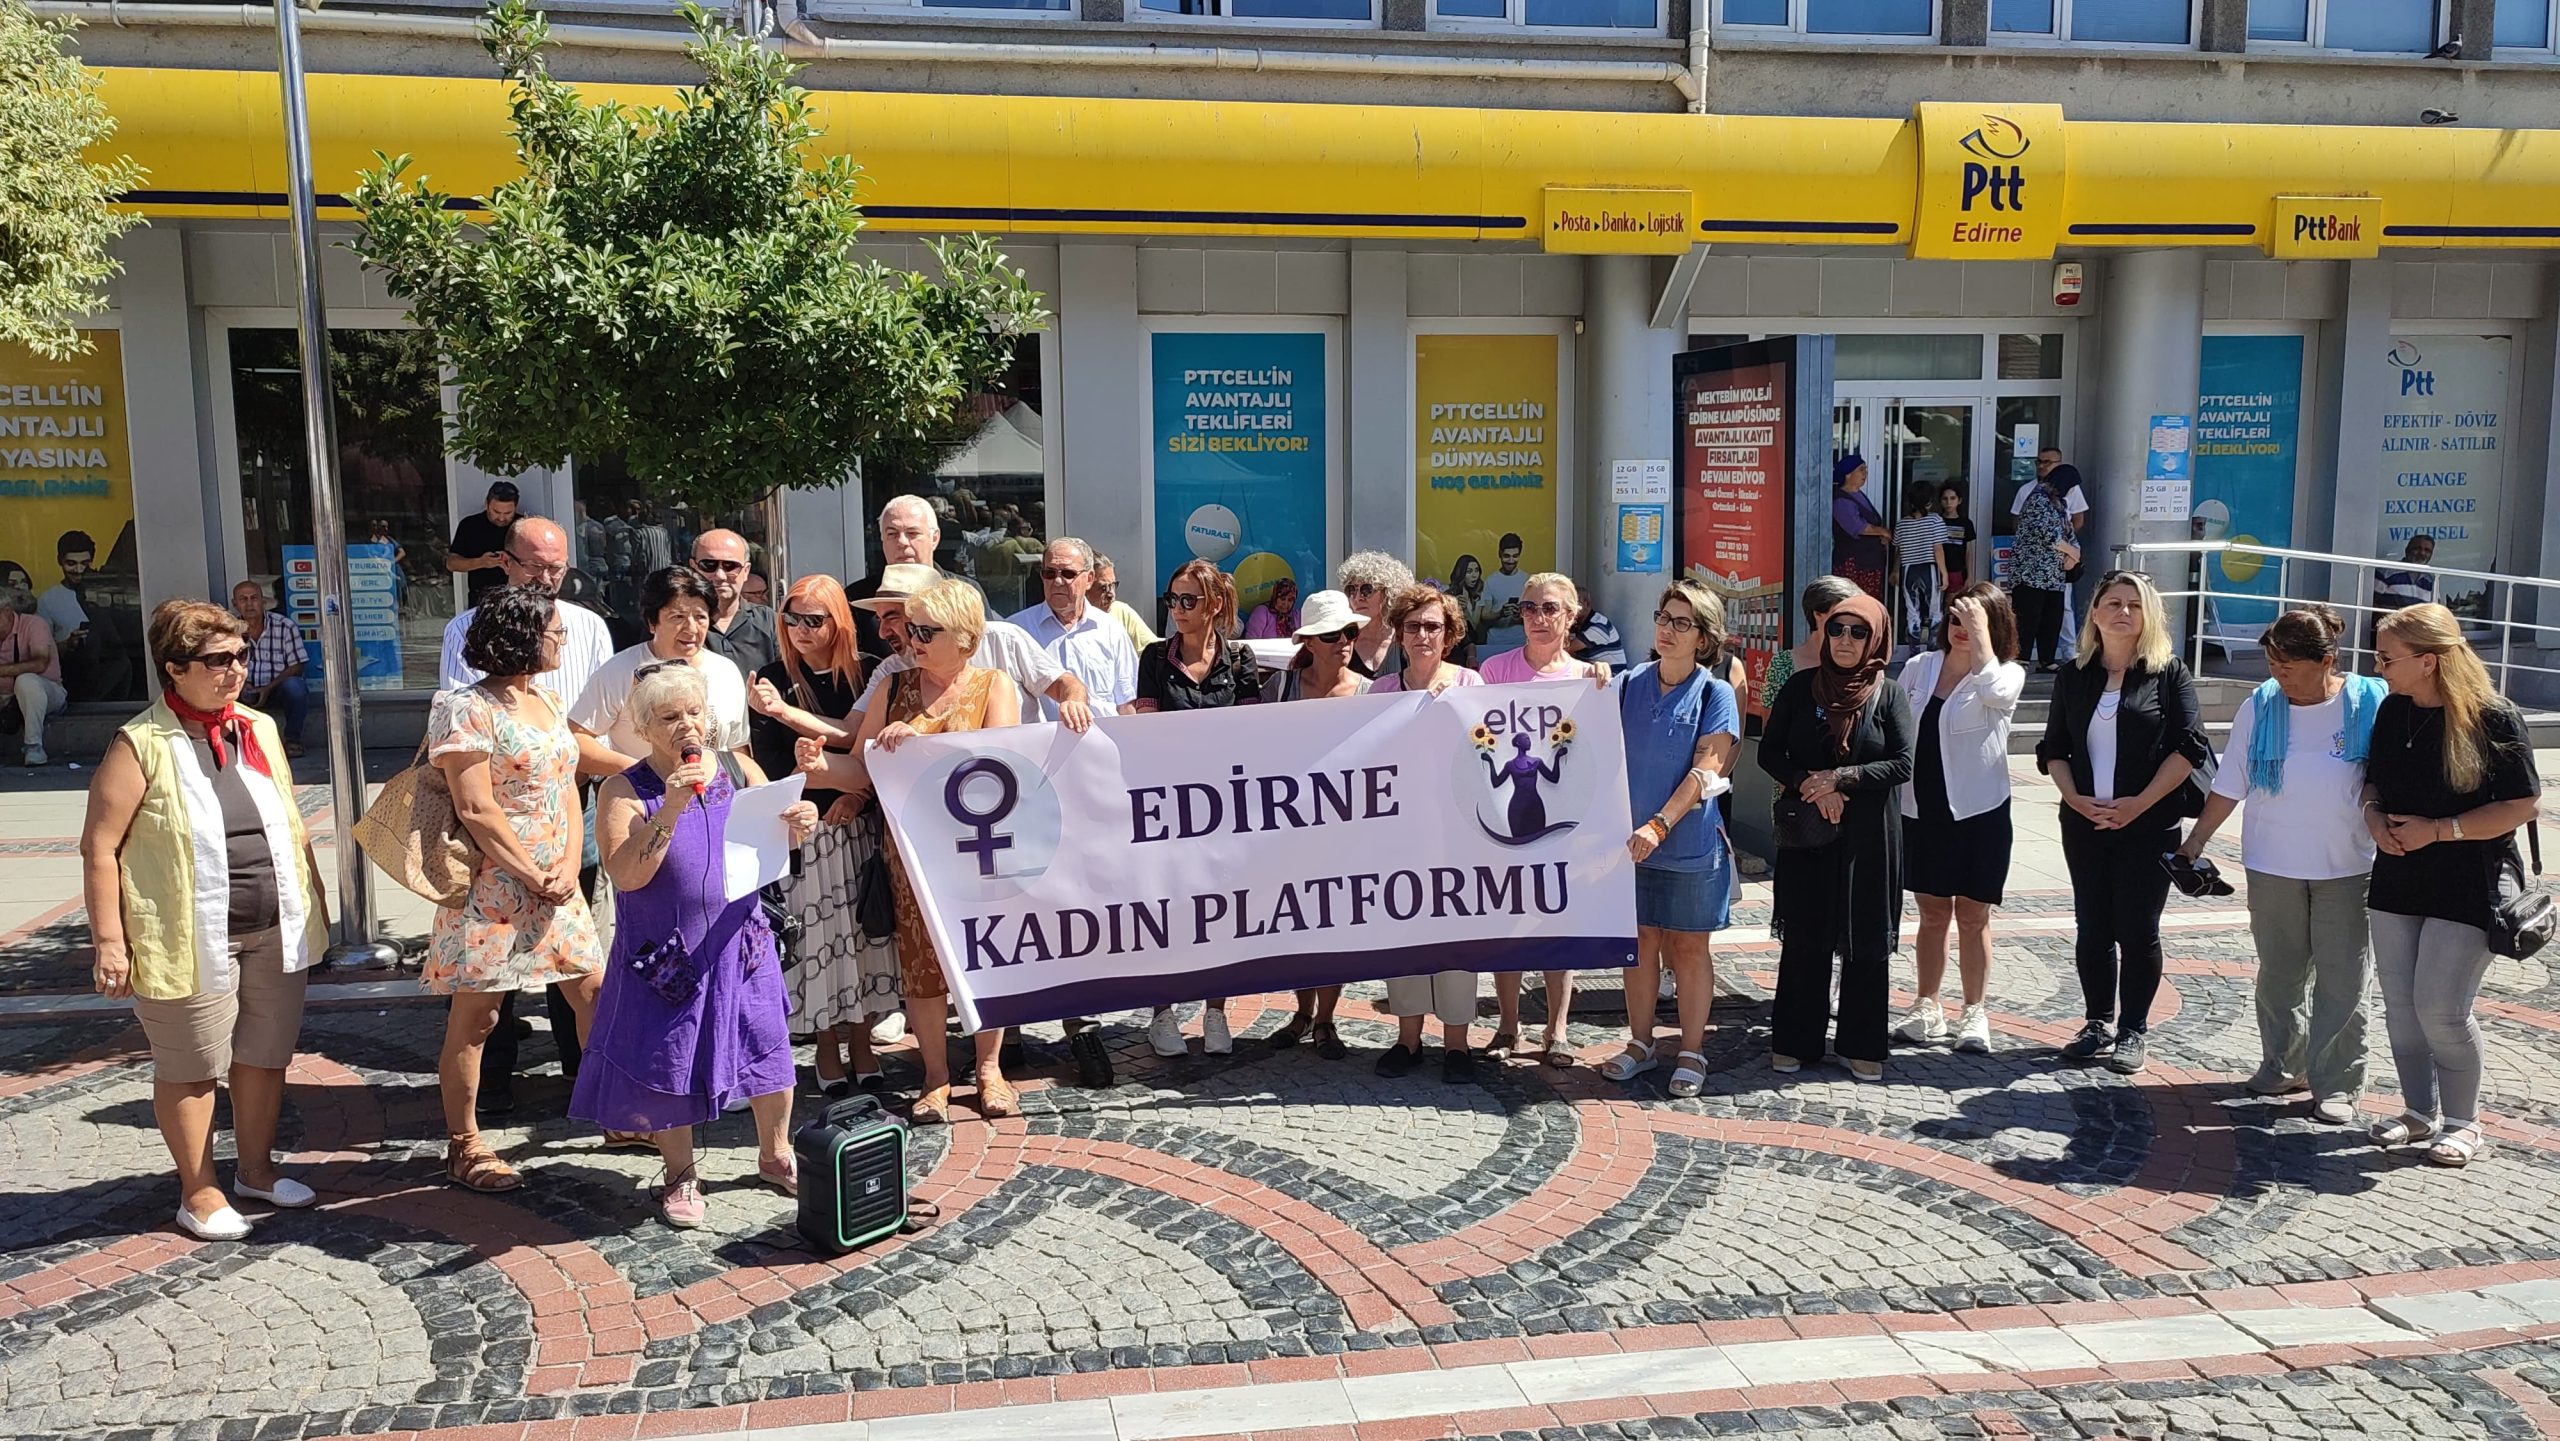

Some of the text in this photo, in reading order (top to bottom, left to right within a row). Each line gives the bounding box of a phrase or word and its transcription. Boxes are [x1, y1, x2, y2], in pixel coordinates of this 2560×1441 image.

[1961, 162, 2025, 212] Ptt
[1561, 210, 1685, 237] Posta Banka Lojistik
[1952, 222, 2023, 243] Edirne
[2294, 214, 2362, 242] PttBank
[1184, 366, 1292, 386] PTTCELL'İN
[2401, 369, 2435, 396] Ptt
[1185, 392, 1291, 408] AVANTAJLI
[1697, 382, 1772, 405] MEKTEBİM KOLEJİ
[2200, 392, 2272, 407] PTTCELL'İN
[1430, 399, 1544, 420] PTTCELL'İN
[1688, 405, 1781, 426] EDİRNE KAMPÜSÜNDE
[2199, 411, 2271, 423] AVANTAJLI
[1184, 410, 1293, 430] TEKLİFLERİ
[2383, 411, 2444, 429] EFEKTİF
[2455, 410, 2498, 427] DÖVİZ
[1430, 427, 1543, 443] AVANTAJLI
[1697, 429, 1772, 445] AVANTAJLI KAYIT
[2197, 424, 2271, 439] TEKLİFLERİ
[1168, 432, 1309, 452] SİZİ BEKLİYOR!
[2382, 437, 2430, 451] ALINIR
[2441, 436, 2497, 450] SATILIR
[1430, 447, 1543, 468] DÜNYASINA
[1708, 451, 1758, 465] FIRSATLARI
[1646, 465, 1655, 473] 25
[1701, 467, 1766, 485] DEVAM EDİYOR
[2397, 472, 2468, 487] CHANGE
[1631, 487, 1640, 495] TL
[1660, 487, 1667, 495] TL
[2384, 499, 2477, 515] EXCHANGE
[1484, 699, 1562, 740] ekp
[1127, 764, 1400, 844] EDİRNE
[960, 861, 1569, 972] KADIN PLATFORMU
